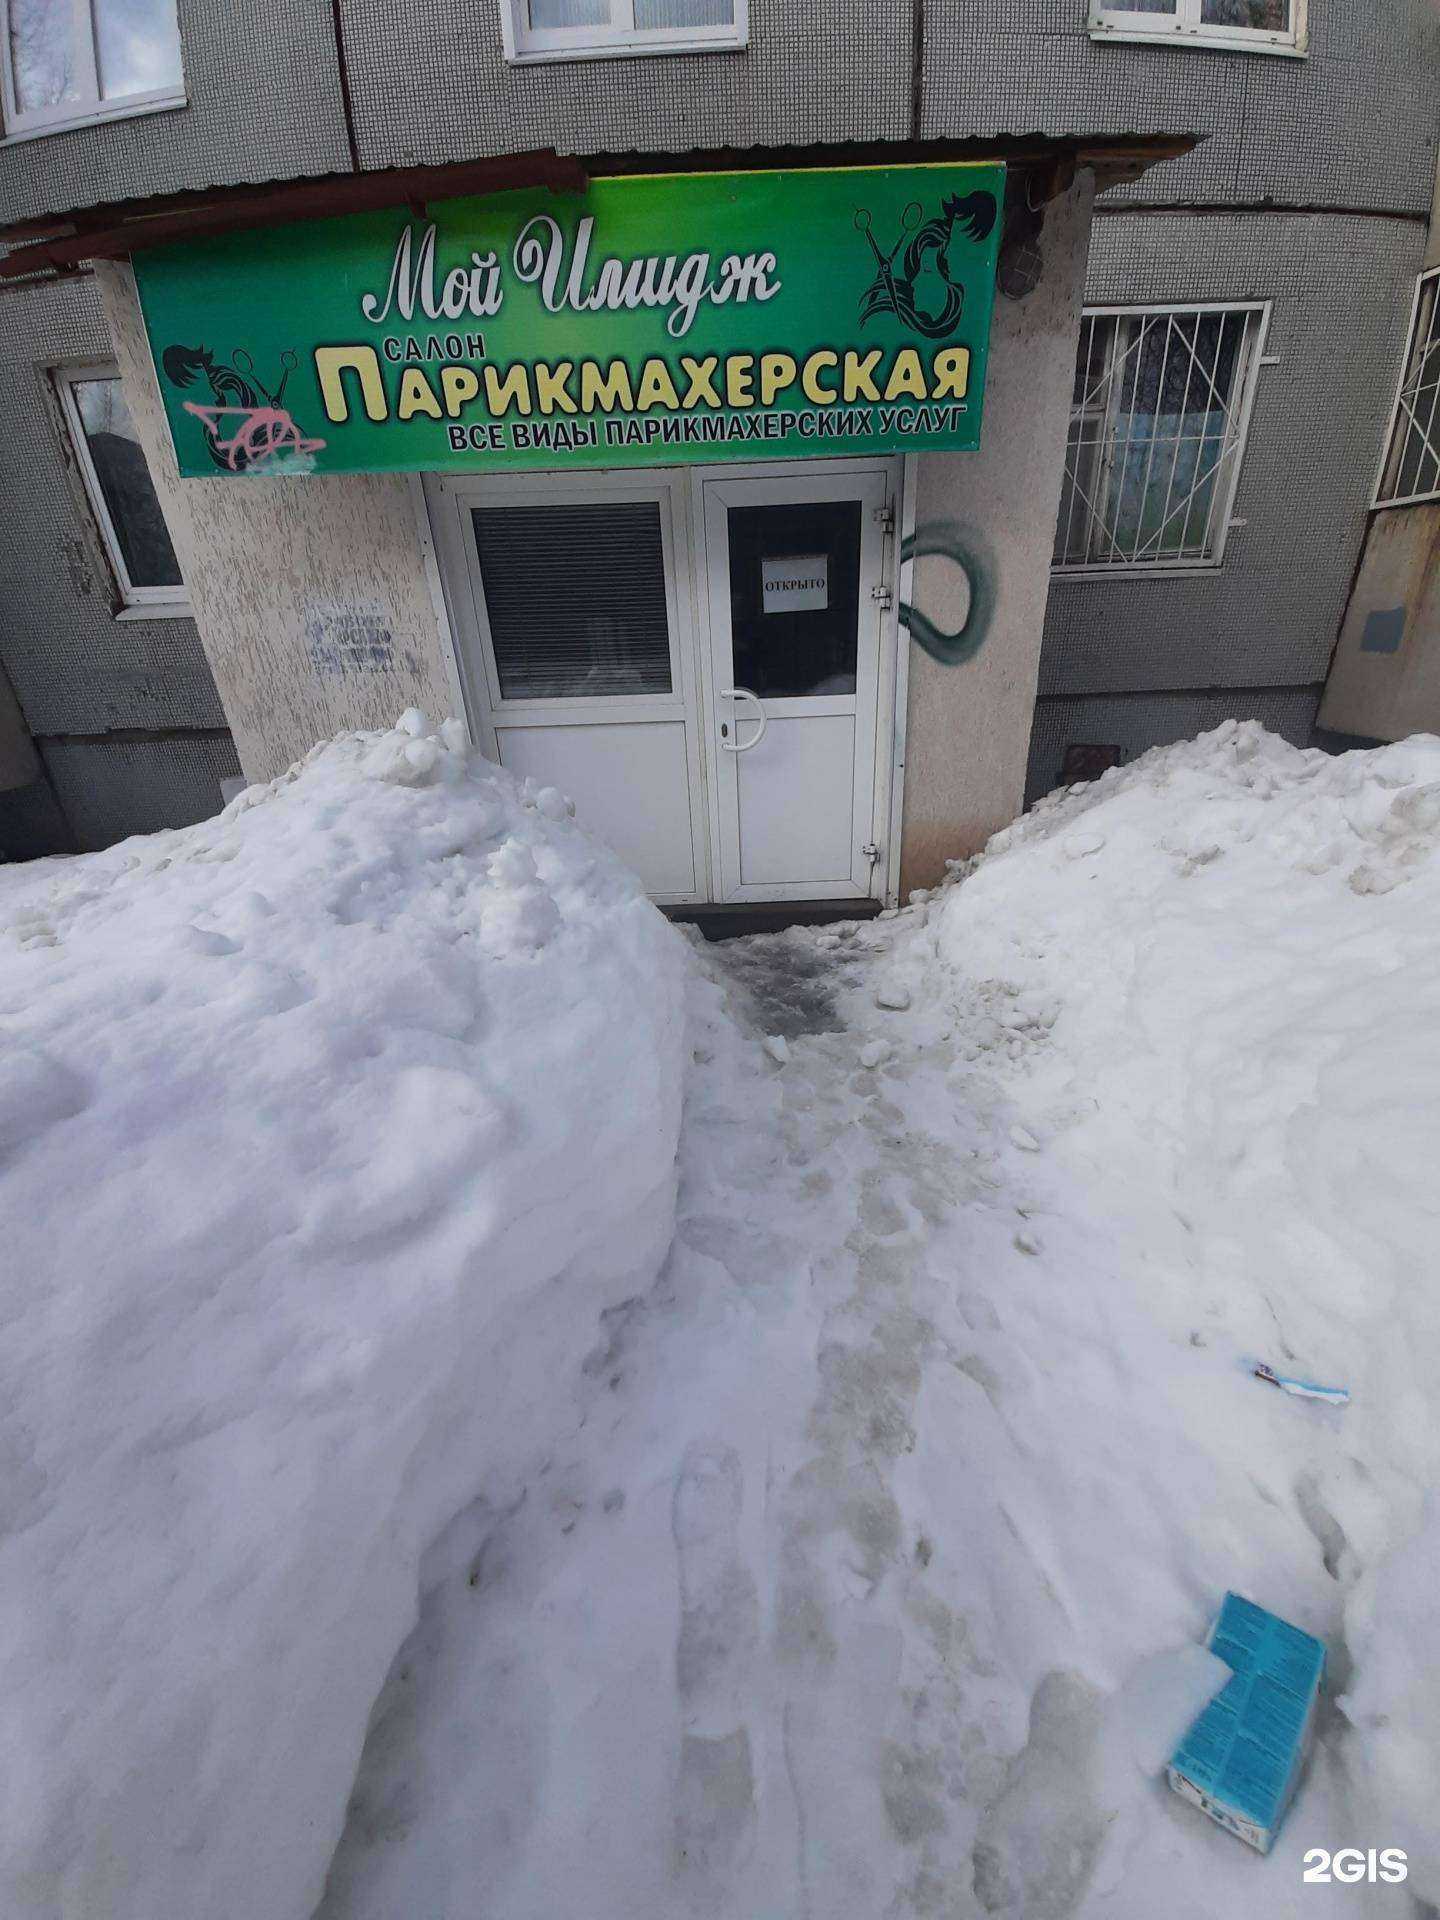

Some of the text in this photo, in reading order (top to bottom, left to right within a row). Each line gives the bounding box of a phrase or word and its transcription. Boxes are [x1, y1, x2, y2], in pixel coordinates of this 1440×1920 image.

[362, 215, 782, 338] Мой Имидж
[383, 333, 486, 363] САЛОН
[313, 346, 971, 423] ПАРИКМАХЕРСКАЯ
[448, 404, 969, 453] ВСЕ ВИДЫ ПАРИКМАХЕРСКИХ УСЛУГ
[765, 578, 825, 593] ОТКРЫТО
